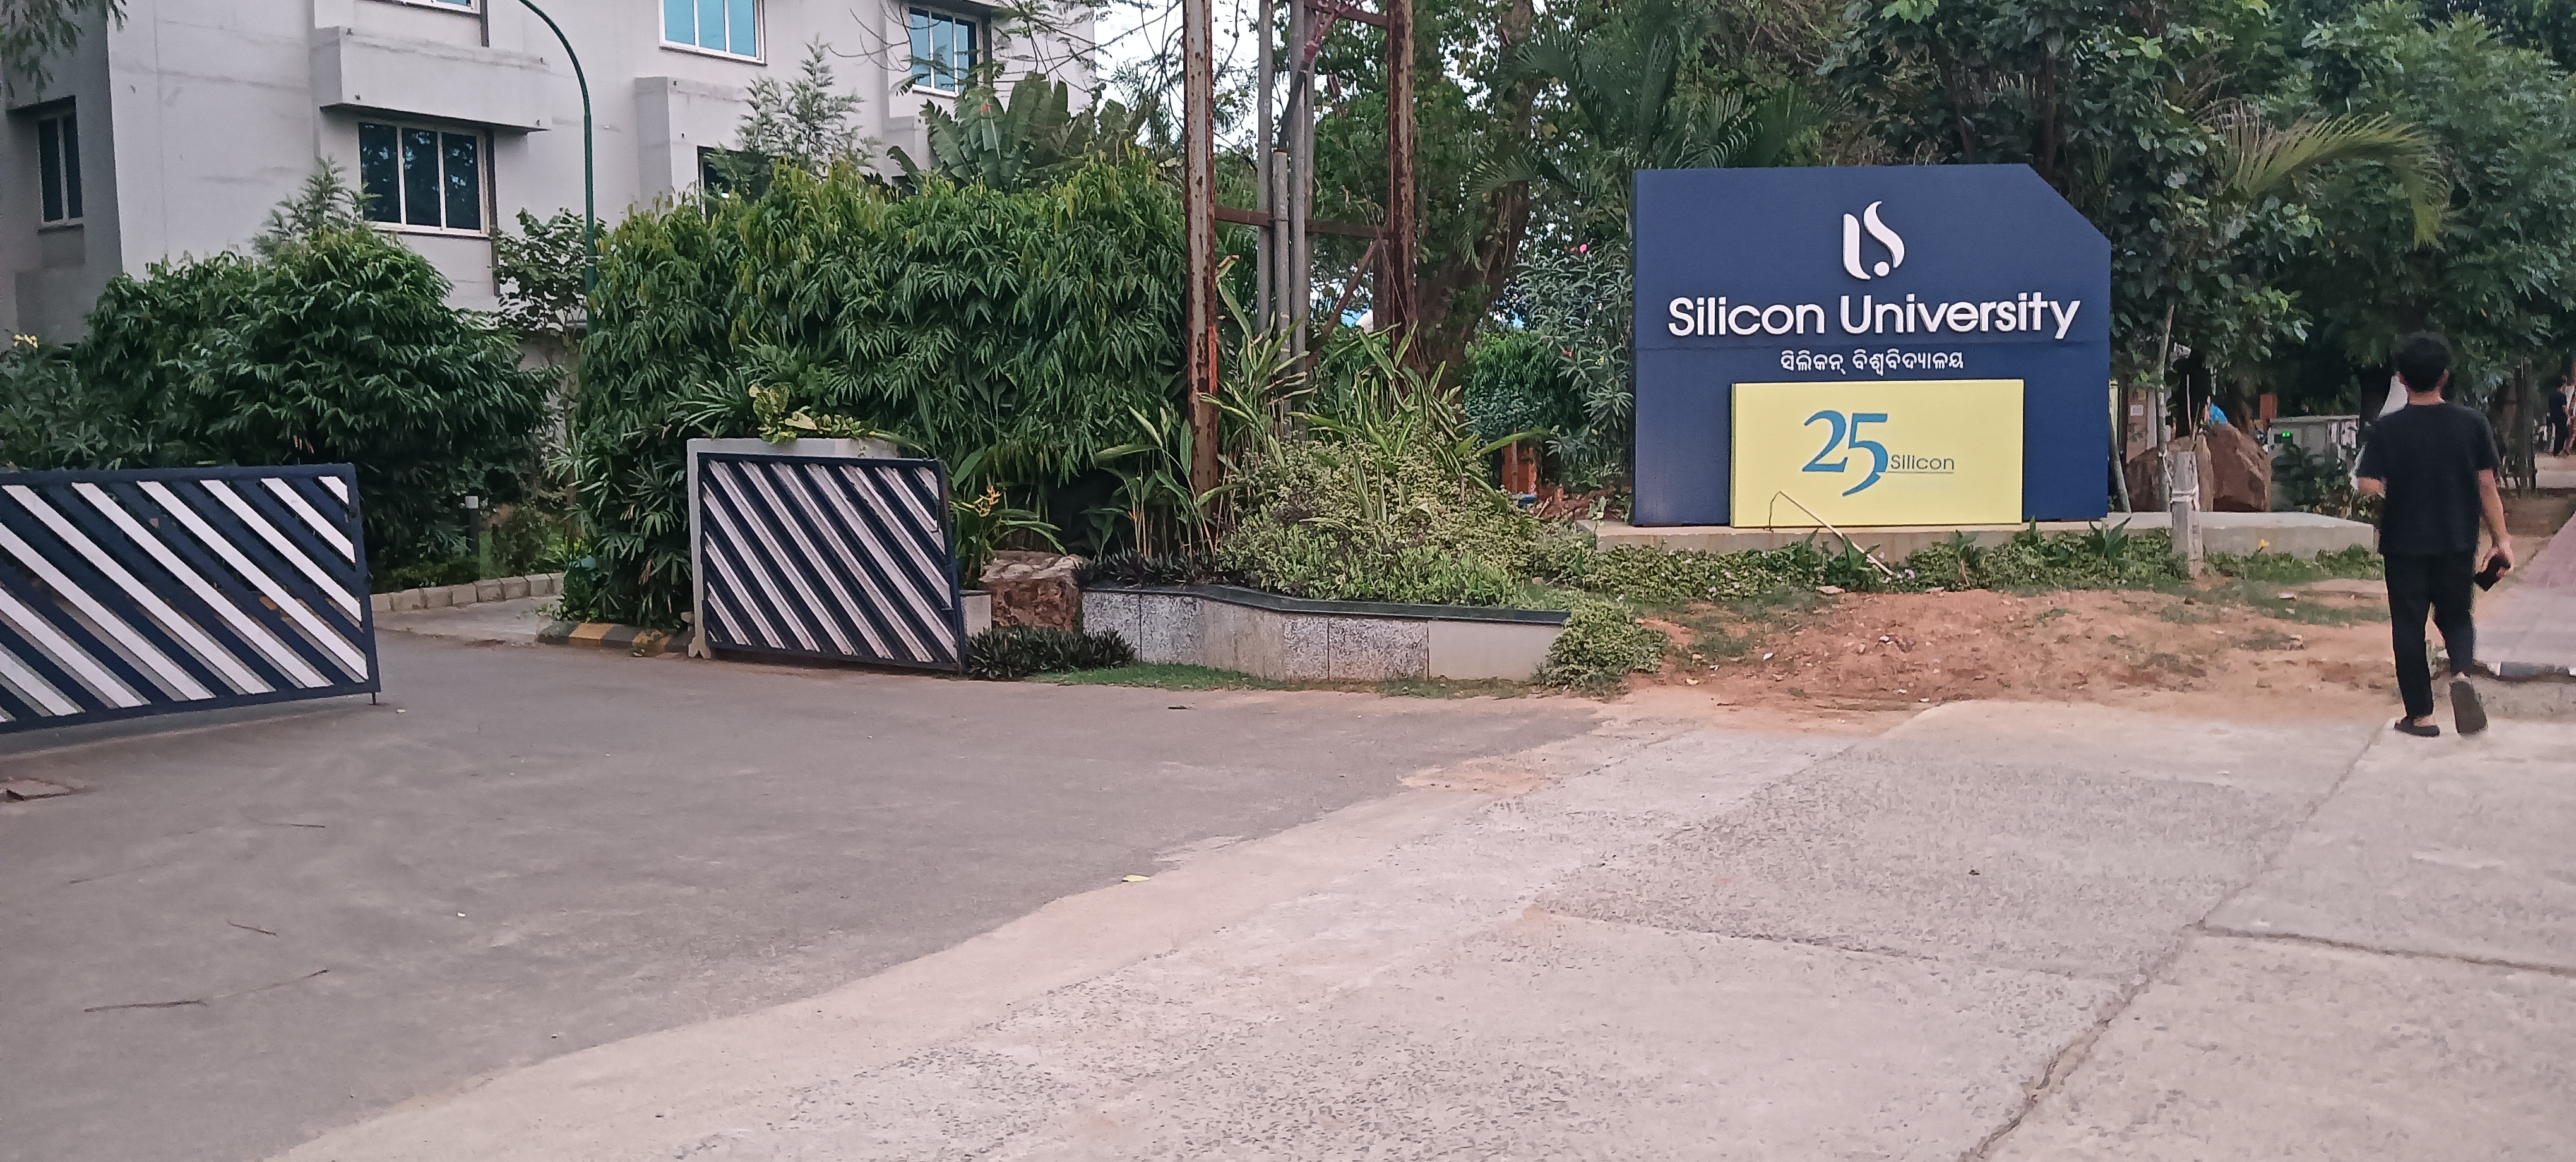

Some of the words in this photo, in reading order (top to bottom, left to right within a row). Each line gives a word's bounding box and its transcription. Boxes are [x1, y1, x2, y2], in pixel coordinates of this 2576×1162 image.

[1668, 296, 1825, 337] Silicon
[1840, 292, 2081, 339] University
[1780, 350, 1846, 375] ସିଲିକନ୍
[1802, 410, 1889, 498] 25
[1890, 454, 1955, 470] Silicon
